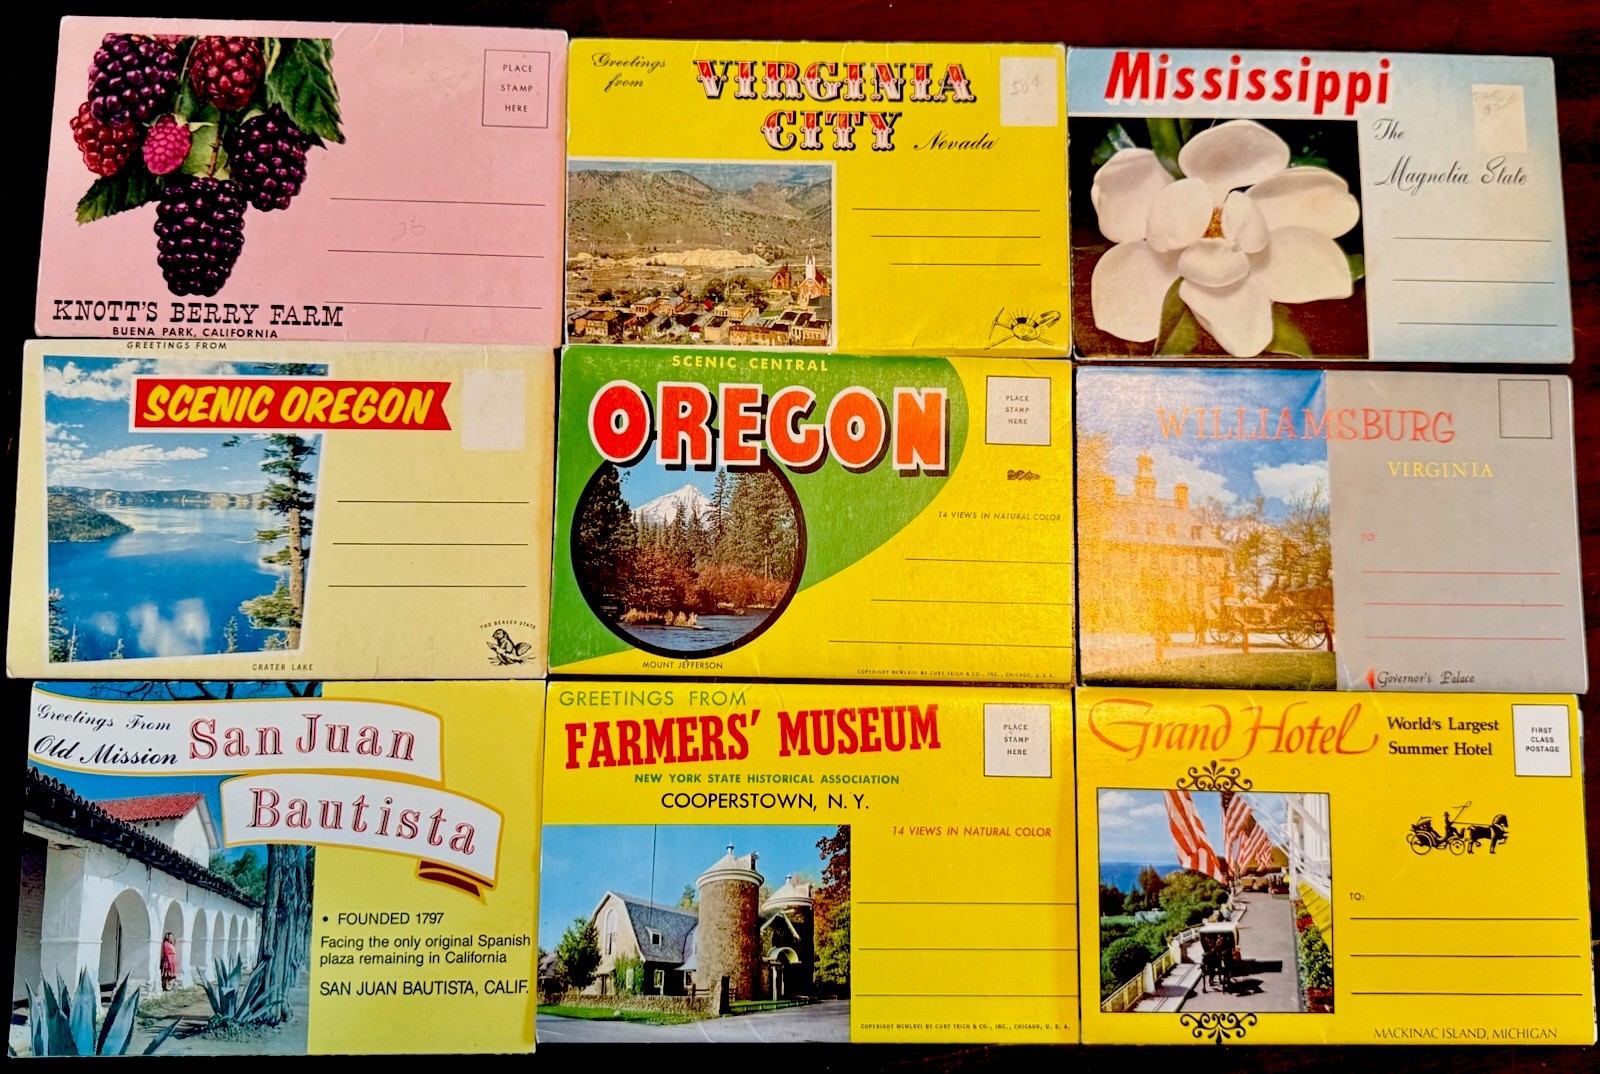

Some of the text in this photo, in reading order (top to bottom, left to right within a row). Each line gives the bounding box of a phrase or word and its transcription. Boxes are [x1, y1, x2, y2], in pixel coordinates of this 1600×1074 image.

[503, 64, 533, 72] PLACE
[591, 52, 666, 73] Greetings
[500, 84, 533, 92] STAMP
[605, 74, 644, 92] from
[693, 59, 977, 102] VIRGINIA
[1105, 51, 1392, 116] Mississippi
[760, 111, 902, 152] CITY
[1371, 118, 1405, 141] The
[914, 130, 999, 152] Nevada
[1374, 156, 1528, 195] Magnolia State
[53, 299, 344, 326] KNOTT'S BERRY FARM
[112, 326, 278, 338] BUENA PARK, CALIFORNIA
[127, 340, 228, 350] GREETINGS FROM
[672, 355, 828, 372] SCENIC CENTRAL
[143, 384, 435, 425] SCENIC OREGON
[588, 380, 951, 475] OREGON
[1156, 407, 1456, 444] WILLIAMSBURG
[1388, 461, 1494, 478] VIRGINIA
[938, 511, 948, 519] 14
[951, 512, 978, 520] VIEWS
[994, 512, 1030, 521] NATURAL
[1034, 514, 1062, 522] COLOR
[1362, 533, 1375, 542] TO
[252, 663, 314, 672] CRATER LAKE
[642, 662, 723, 670] MOUNT JEFFERSON
[1377, 670, 1475, 687] Governor's Palace
[559, 691, 746, 707] GREETINGS FROM
[36, 704, 171, 731] Greetings From
[1388, 717, 1499, 736] World's Largest
[189, 713, 416, 761] San Juan
[565, 704, 940, 769] FARMERS' MUSEUM
[1088, 698, 1378, 762] Grand Hotel
[33, 735, 178, 765] Old Mission
[1389, 742, 1493, 756] Summer Hotel
[634, 773, 900, 785] NEW YORK STATE HISTORICAL ASSOCIATION
[662, 793, 870, 812] COOPERSTOWN, N. Y.
[247, 787, 476, 856] Bautista
[892, 826, 1051, 838] 14 VIEWS IN NATURAL COLOR
[338, 912, 444, 926] FOUNDED 1797
[320, 934, 530, 950] Facing the only original Spanish
[320, 951, 507, 968] plaza remaining in California
[320, 980, 529, 998] SAN JUAN BAUTISTA, CALIF.
[1374, 1028, 1557, 1041] MACKINAC ISLAND, MICHIGAN
